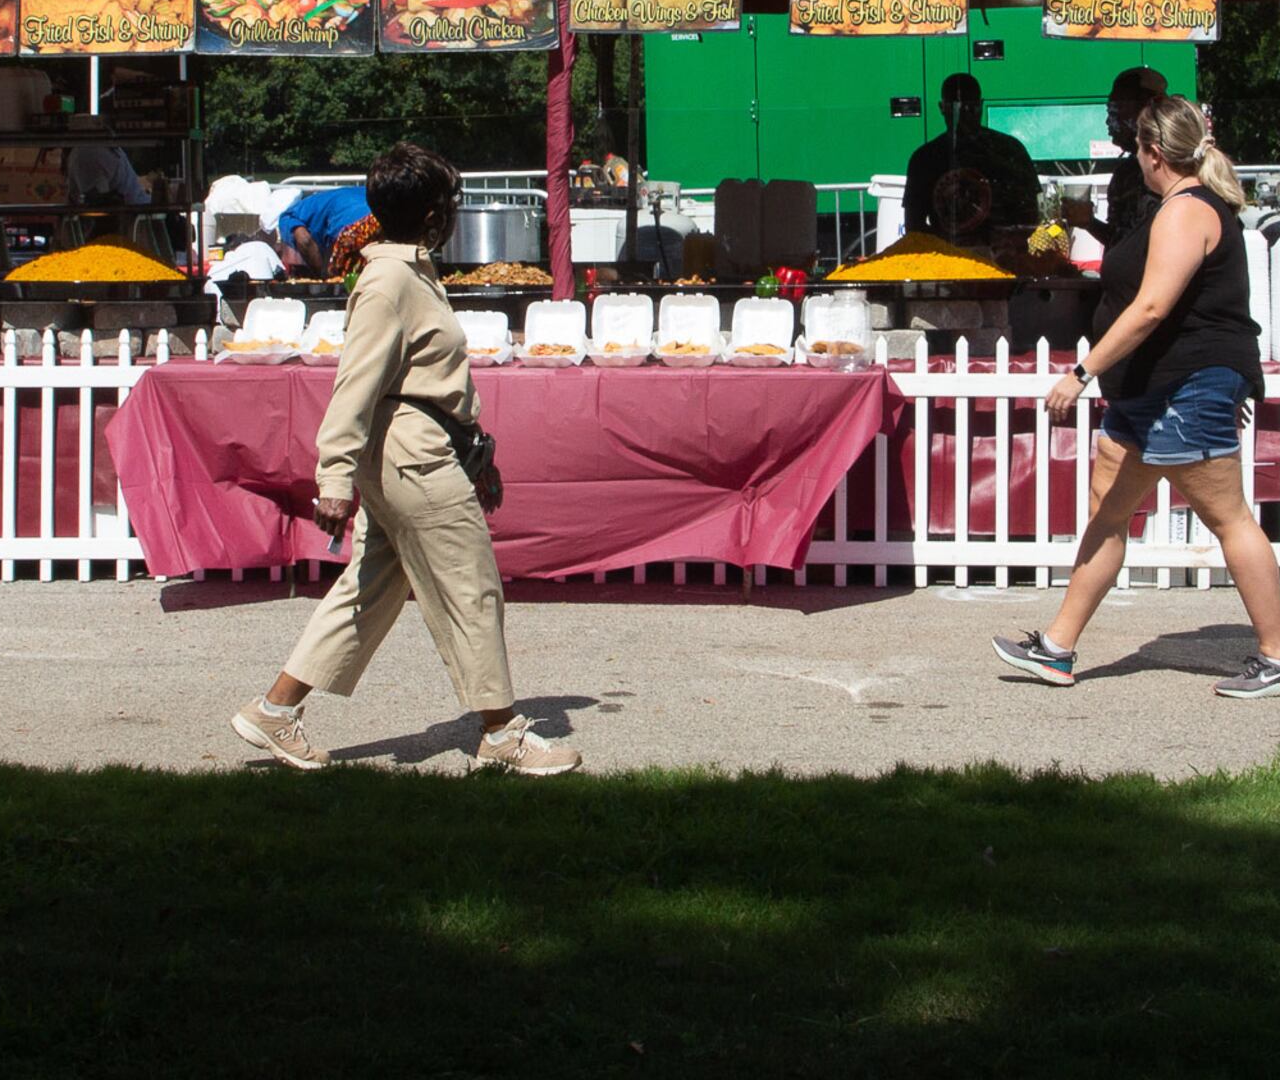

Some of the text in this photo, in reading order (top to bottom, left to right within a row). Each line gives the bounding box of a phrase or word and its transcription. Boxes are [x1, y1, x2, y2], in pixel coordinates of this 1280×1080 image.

[632, 1, 683, 27] Wings
[685, 3, 698, 21] &
[699, 0, 735, 22] Fish
[890, 1, 904, 23] &
[1141, 3, 1155, 26] &
[24, 15, 189, 47] Fried Fish & Shrimp
[229, 18, 339, 48] Grilled Shrimp
[410, 17, 526, 47] Grilled Chicken
